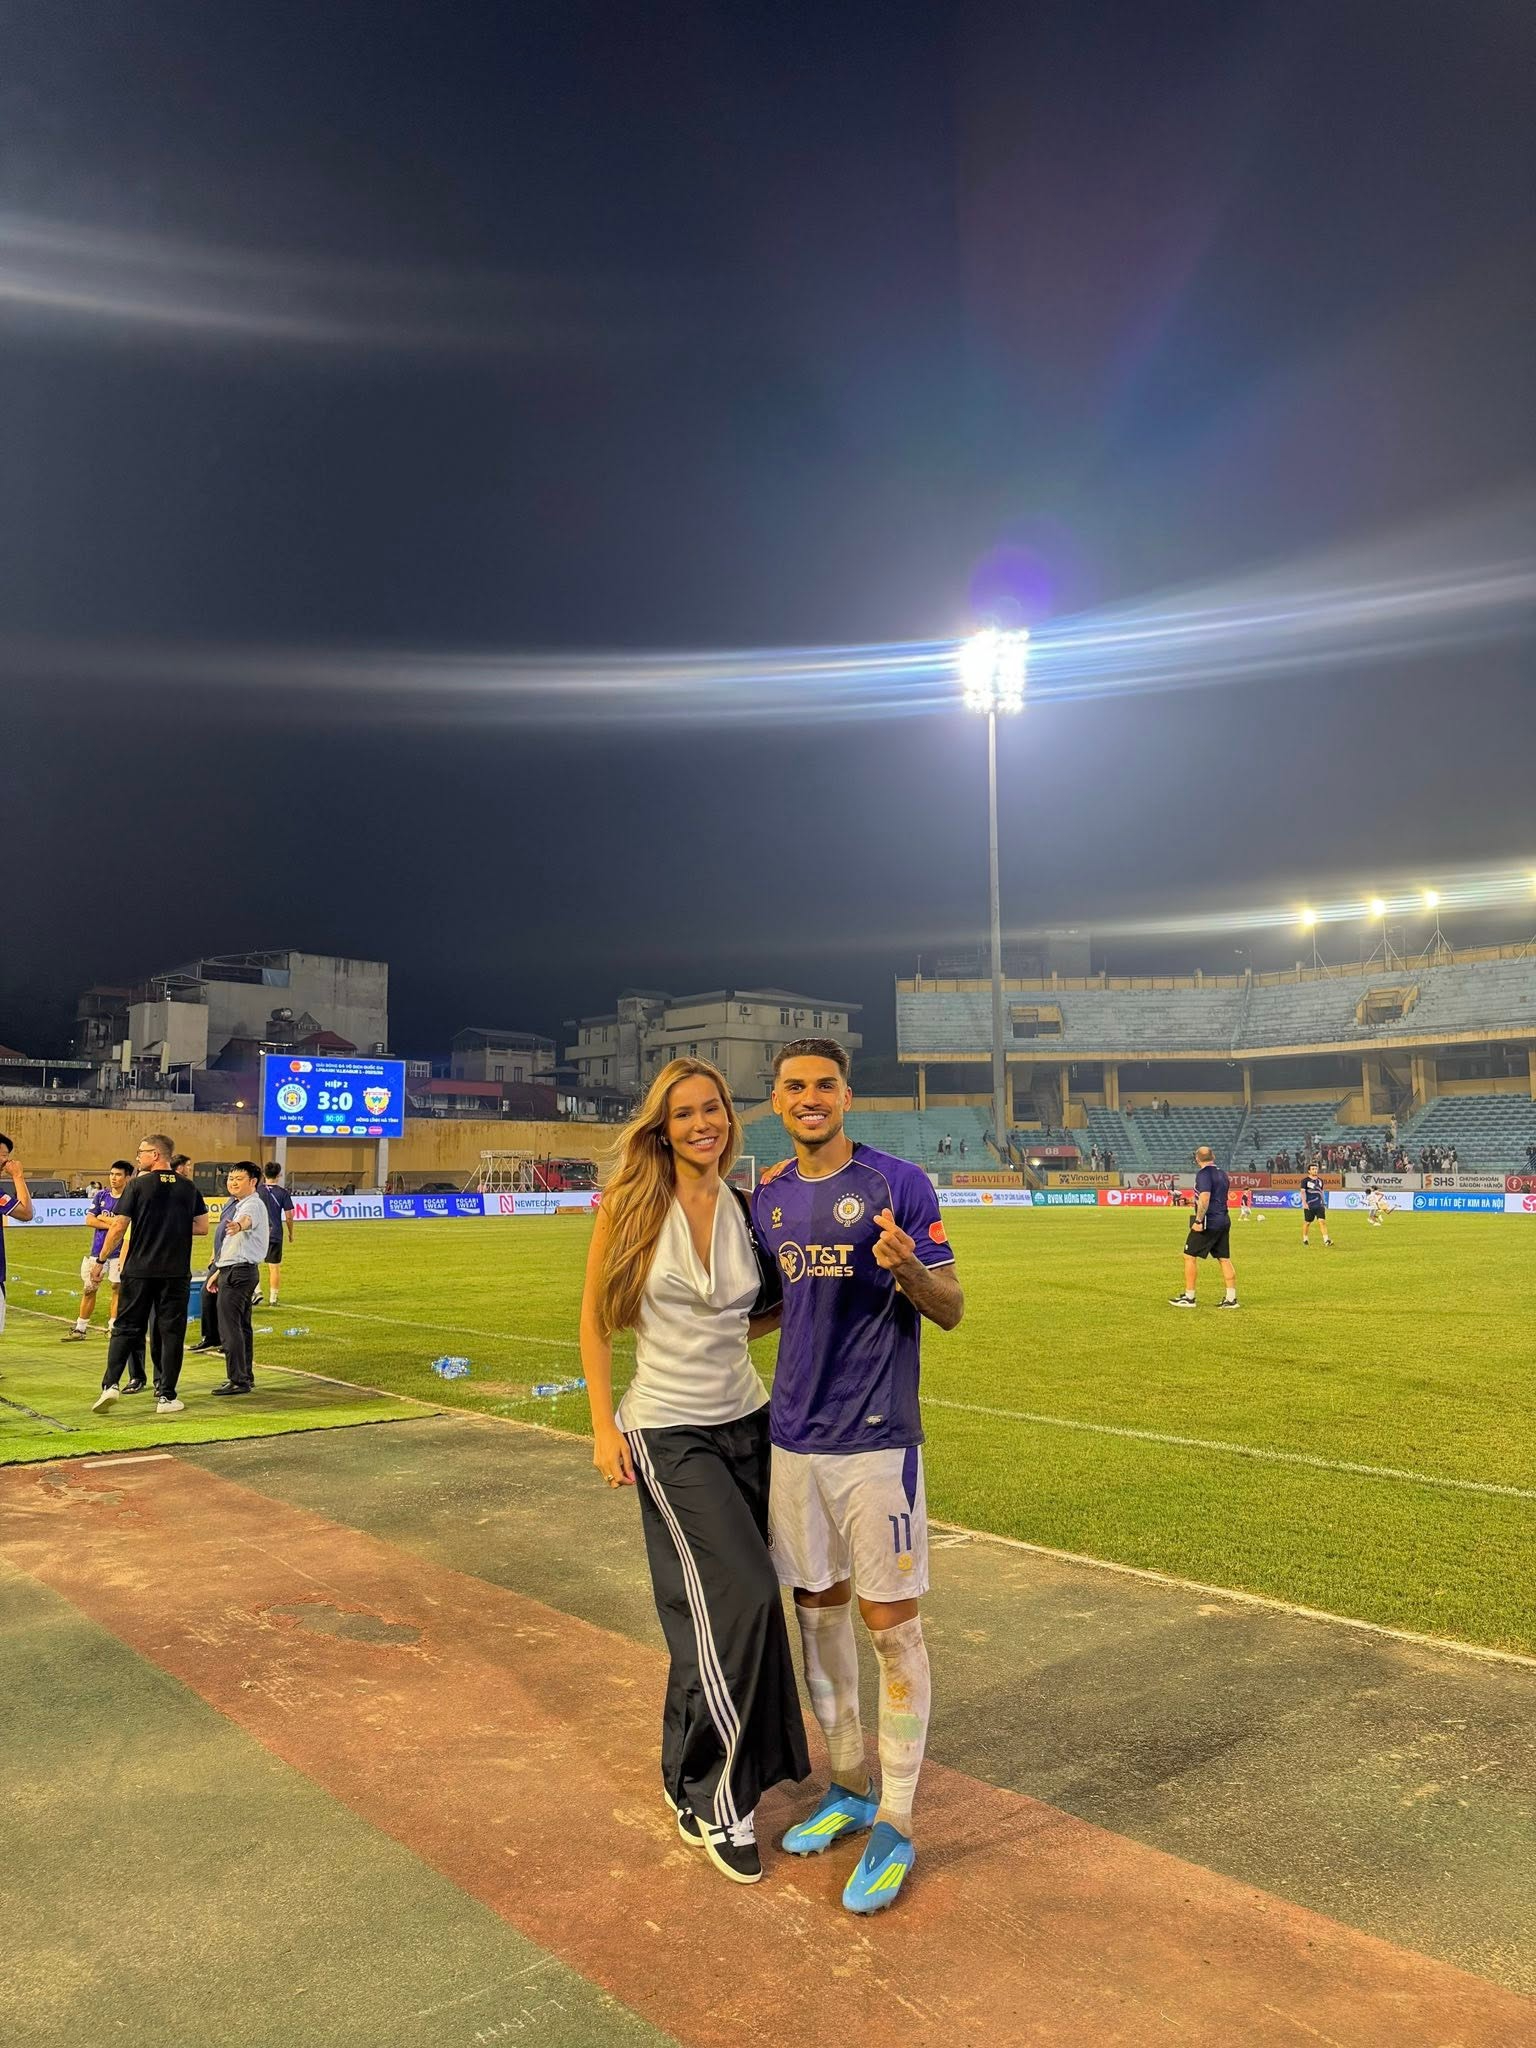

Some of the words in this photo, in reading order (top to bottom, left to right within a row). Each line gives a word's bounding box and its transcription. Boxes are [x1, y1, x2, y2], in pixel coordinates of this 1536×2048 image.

[325, 1079, 342, 1089] HIỆP
[317, 1091, 353, 1111] 3:0
[1045, 1147, 1059, 1155] 08
[972, 1175, 986, 1183] BIA
[1241, 1176, 1261, 1187] Play
[1433, 1177, 1454, 1186] SHS
[1124, 1193, 1143, 1202] FPT
[1146, 1192, 1168, 1204] Play
[1468, 1198, 1480, 1207] KIM
[515, 1200, 560, 1208] NEWTECONS
[47, 1208, 66, 1217] IPC
[805, 1244, 854, 1265] T&T
[807, 1265, 854, 1277] HOMES
[888, 1512, 912, 1554] 11
